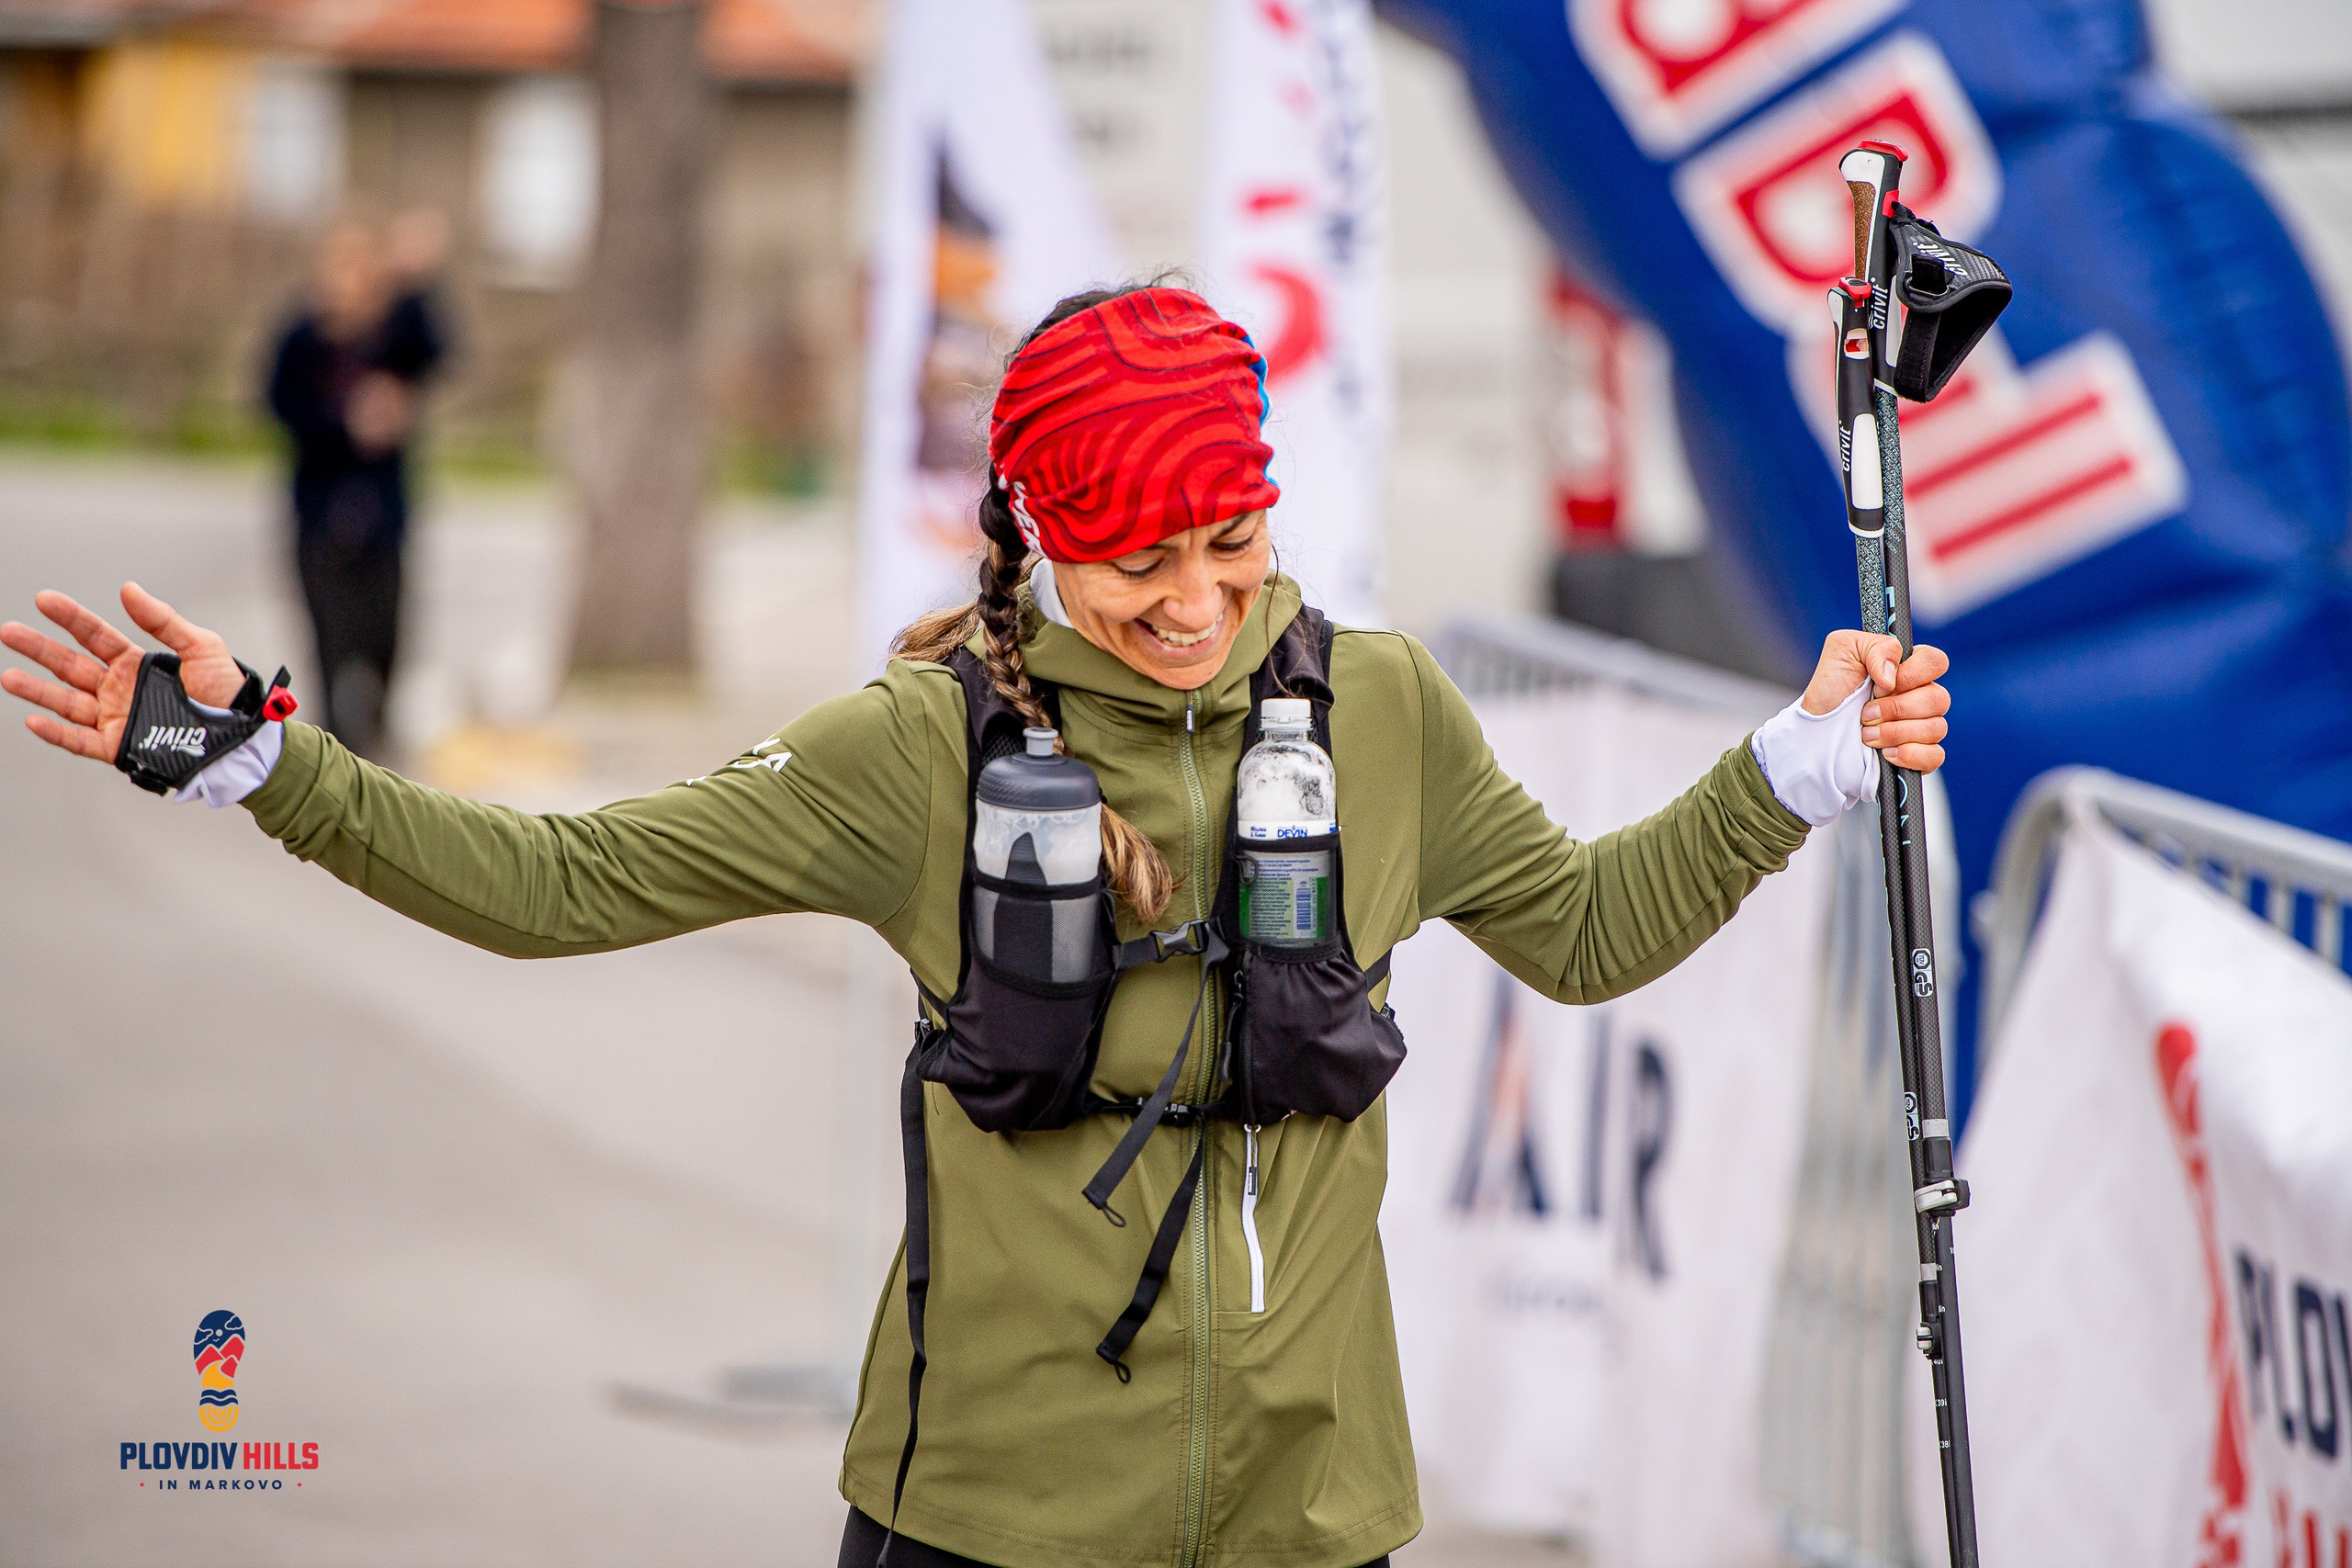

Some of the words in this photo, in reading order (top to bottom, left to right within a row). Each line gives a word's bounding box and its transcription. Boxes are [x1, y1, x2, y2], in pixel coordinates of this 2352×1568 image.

[1871, 278, 1889, 330] crivit
[1838, 421, 1851, 472] crivit
[140, 725, 207, 752] crivit
[1915, 971, 1933, 996] GS
